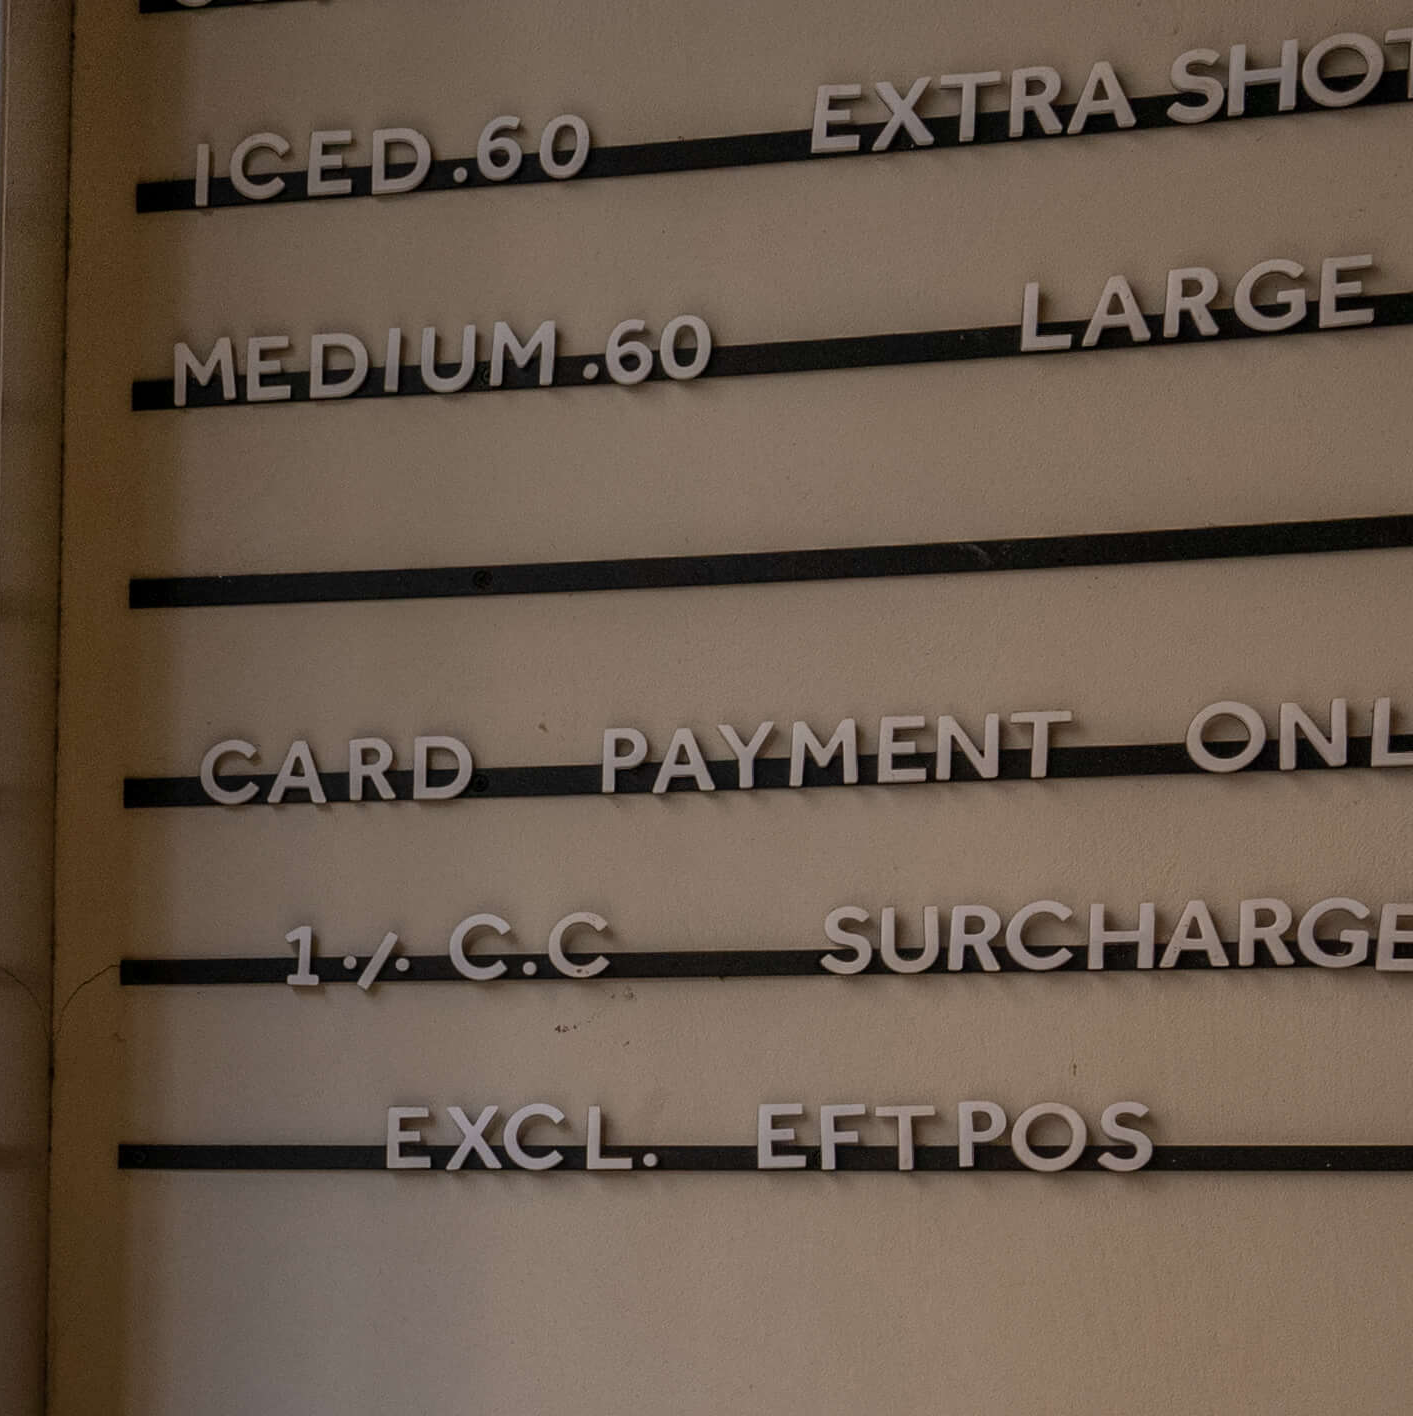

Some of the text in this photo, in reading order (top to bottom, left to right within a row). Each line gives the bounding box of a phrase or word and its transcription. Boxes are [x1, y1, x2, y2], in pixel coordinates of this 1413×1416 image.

[810, 60, 1137, 154] EXTRA
[1019, 254, 1376, 353] LARGE
[199, 735, 474, 806] CARD
[599, 709, 1073, 795] PAYMENT
[819, 896, 1413, 975] SURCHARGE
[384, 1100, 1155, 1173] EXCL. EFTPOS
